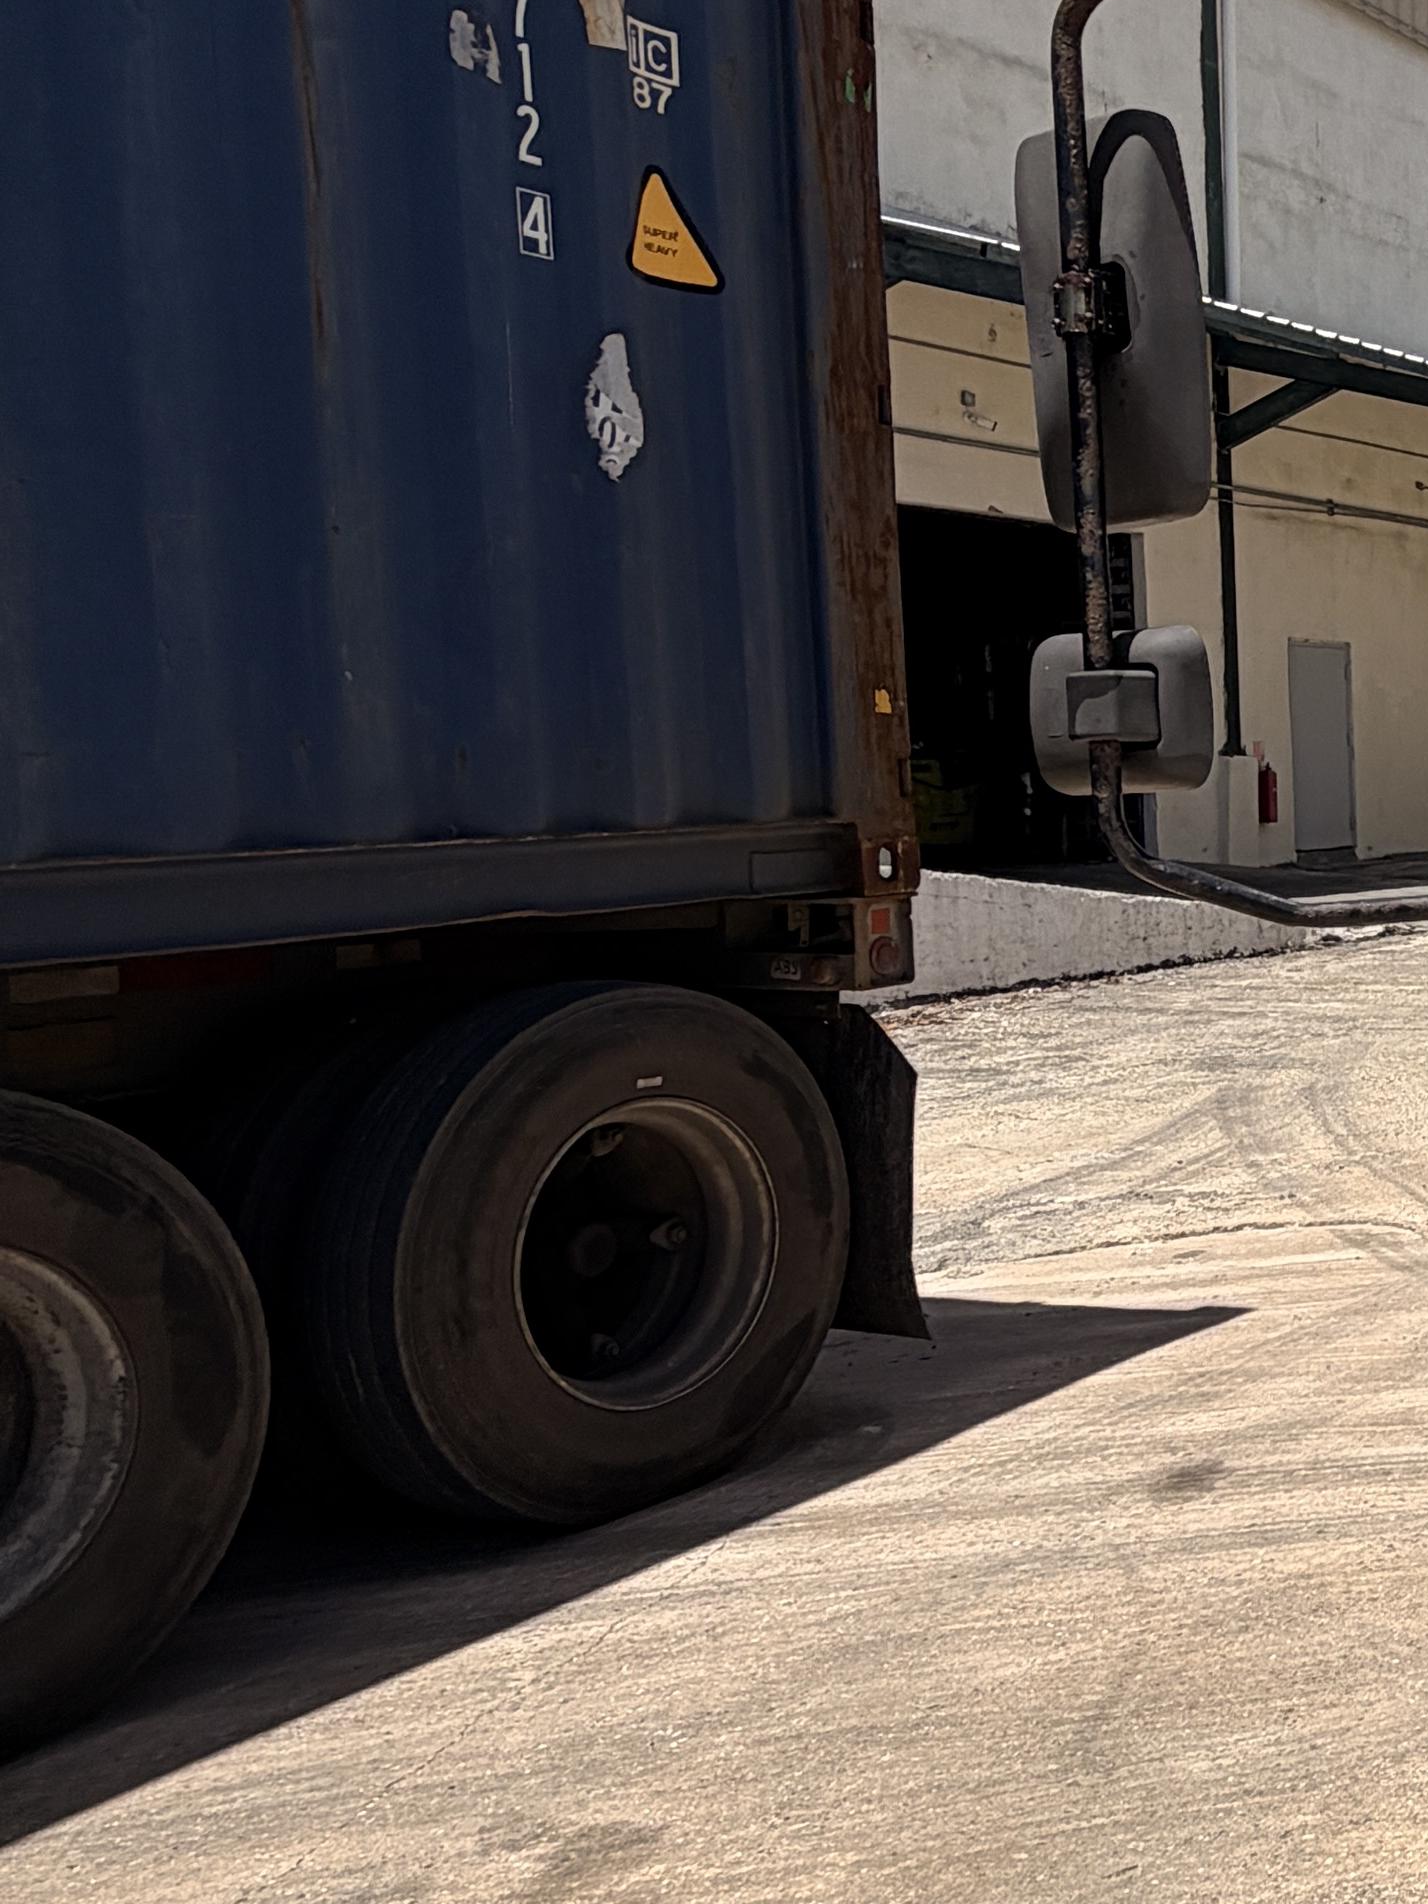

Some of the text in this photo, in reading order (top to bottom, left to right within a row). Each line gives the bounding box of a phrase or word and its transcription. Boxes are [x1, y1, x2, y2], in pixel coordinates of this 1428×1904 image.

[633, 77, 672, 114] 87
[523, 196, 548, 255] 4
[643, 224, 679, 242] SUPER
